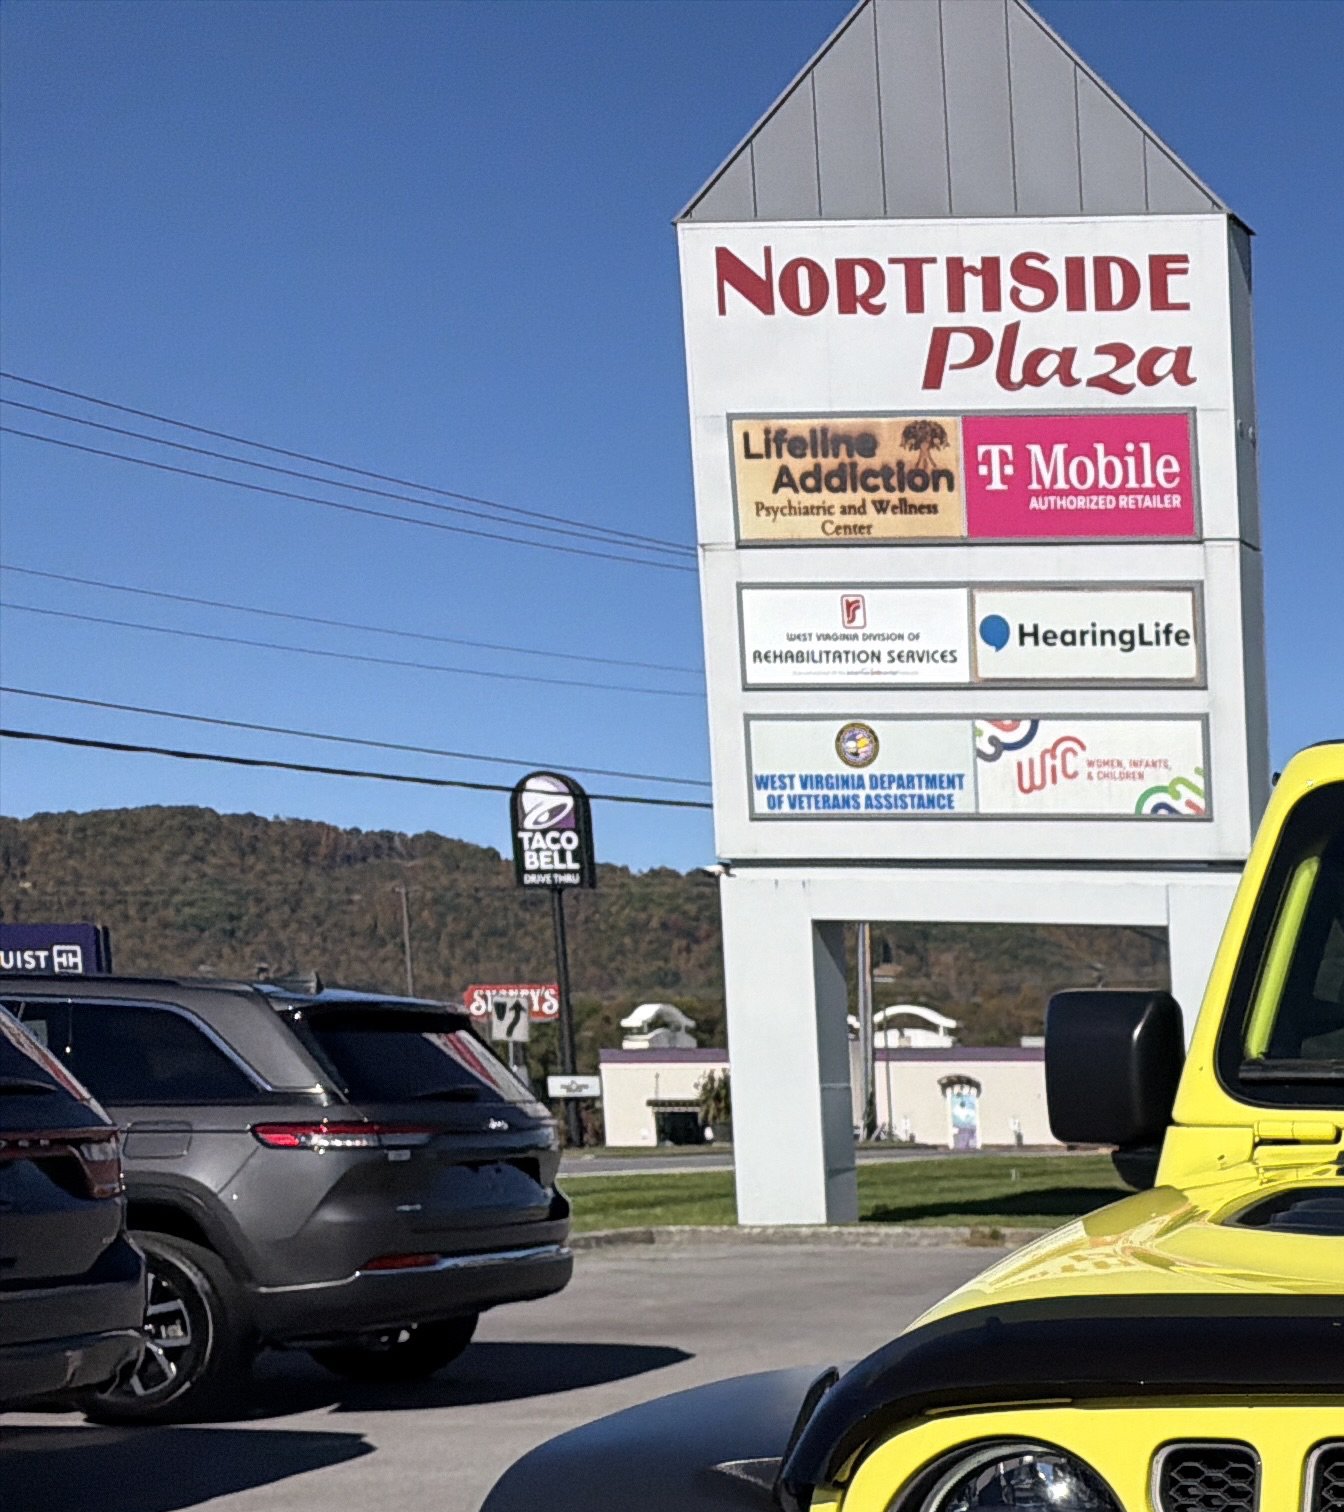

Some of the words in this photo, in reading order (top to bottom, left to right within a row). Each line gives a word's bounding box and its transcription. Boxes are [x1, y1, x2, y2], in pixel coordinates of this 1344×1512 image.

[714, 245, 1191, 317] NORTHSIDE
[920, 320, 1198, 395] Plaza
[743, 426, 879, 459] Lifeline
[772, 460, 955, 494] Addiction
[1026, 443, 1182, 491] Mobile
[754, 498, 834, 521] Psychiatric
[839, 499, 868, 516] and
[871, 498, 939, 516] Wellness
[1028, 495, 1116, 511] AUTHORIZED
[1119, 494, 1182, 509] RETAILER
[821, 519, 873, 536] Center
[1018, 622, 1191, 652] HearingLife
[752, 650, 881, 665] REHABILITATION
[887, 649, 958, 664] SERVICES
[755, 774, 795, 791] WEST
[799, 774, 865, 791] VIRGINIA
[869, 773, 964, 791] DEPARTMENT
[766, 793, 784, 810] OF
[787, 793, 862, 810] VETERANS
[865, 793, 955, 810] ASSISTANCE
[518, 831, 579, 850] TACO
[524, 851, 580, 870] BELL
